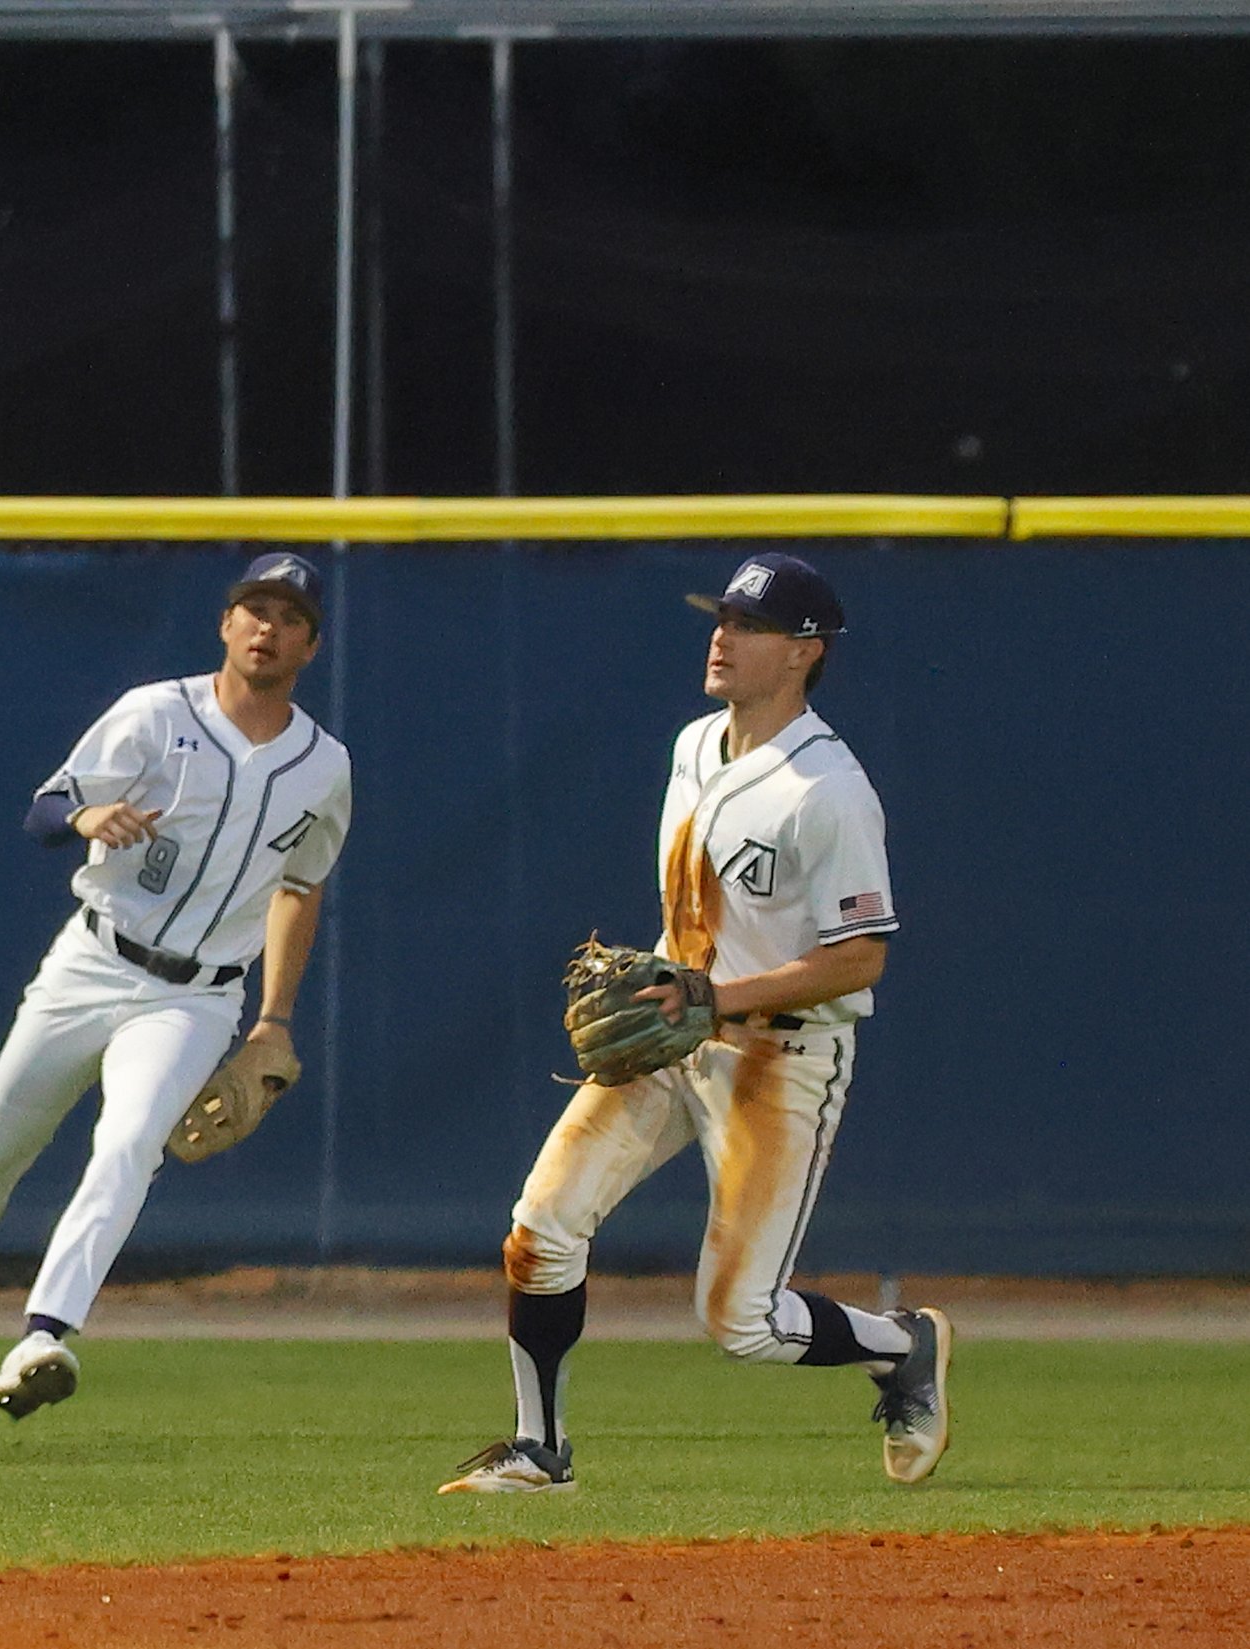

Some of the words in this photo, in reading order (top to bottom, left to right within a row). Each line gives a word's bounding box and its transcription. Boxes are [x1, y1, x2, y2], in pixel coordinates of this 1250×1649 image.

[725, 563, 777, 600] A
[138, 834, 180, 895] 9
[718, 837, 777, 896] A
